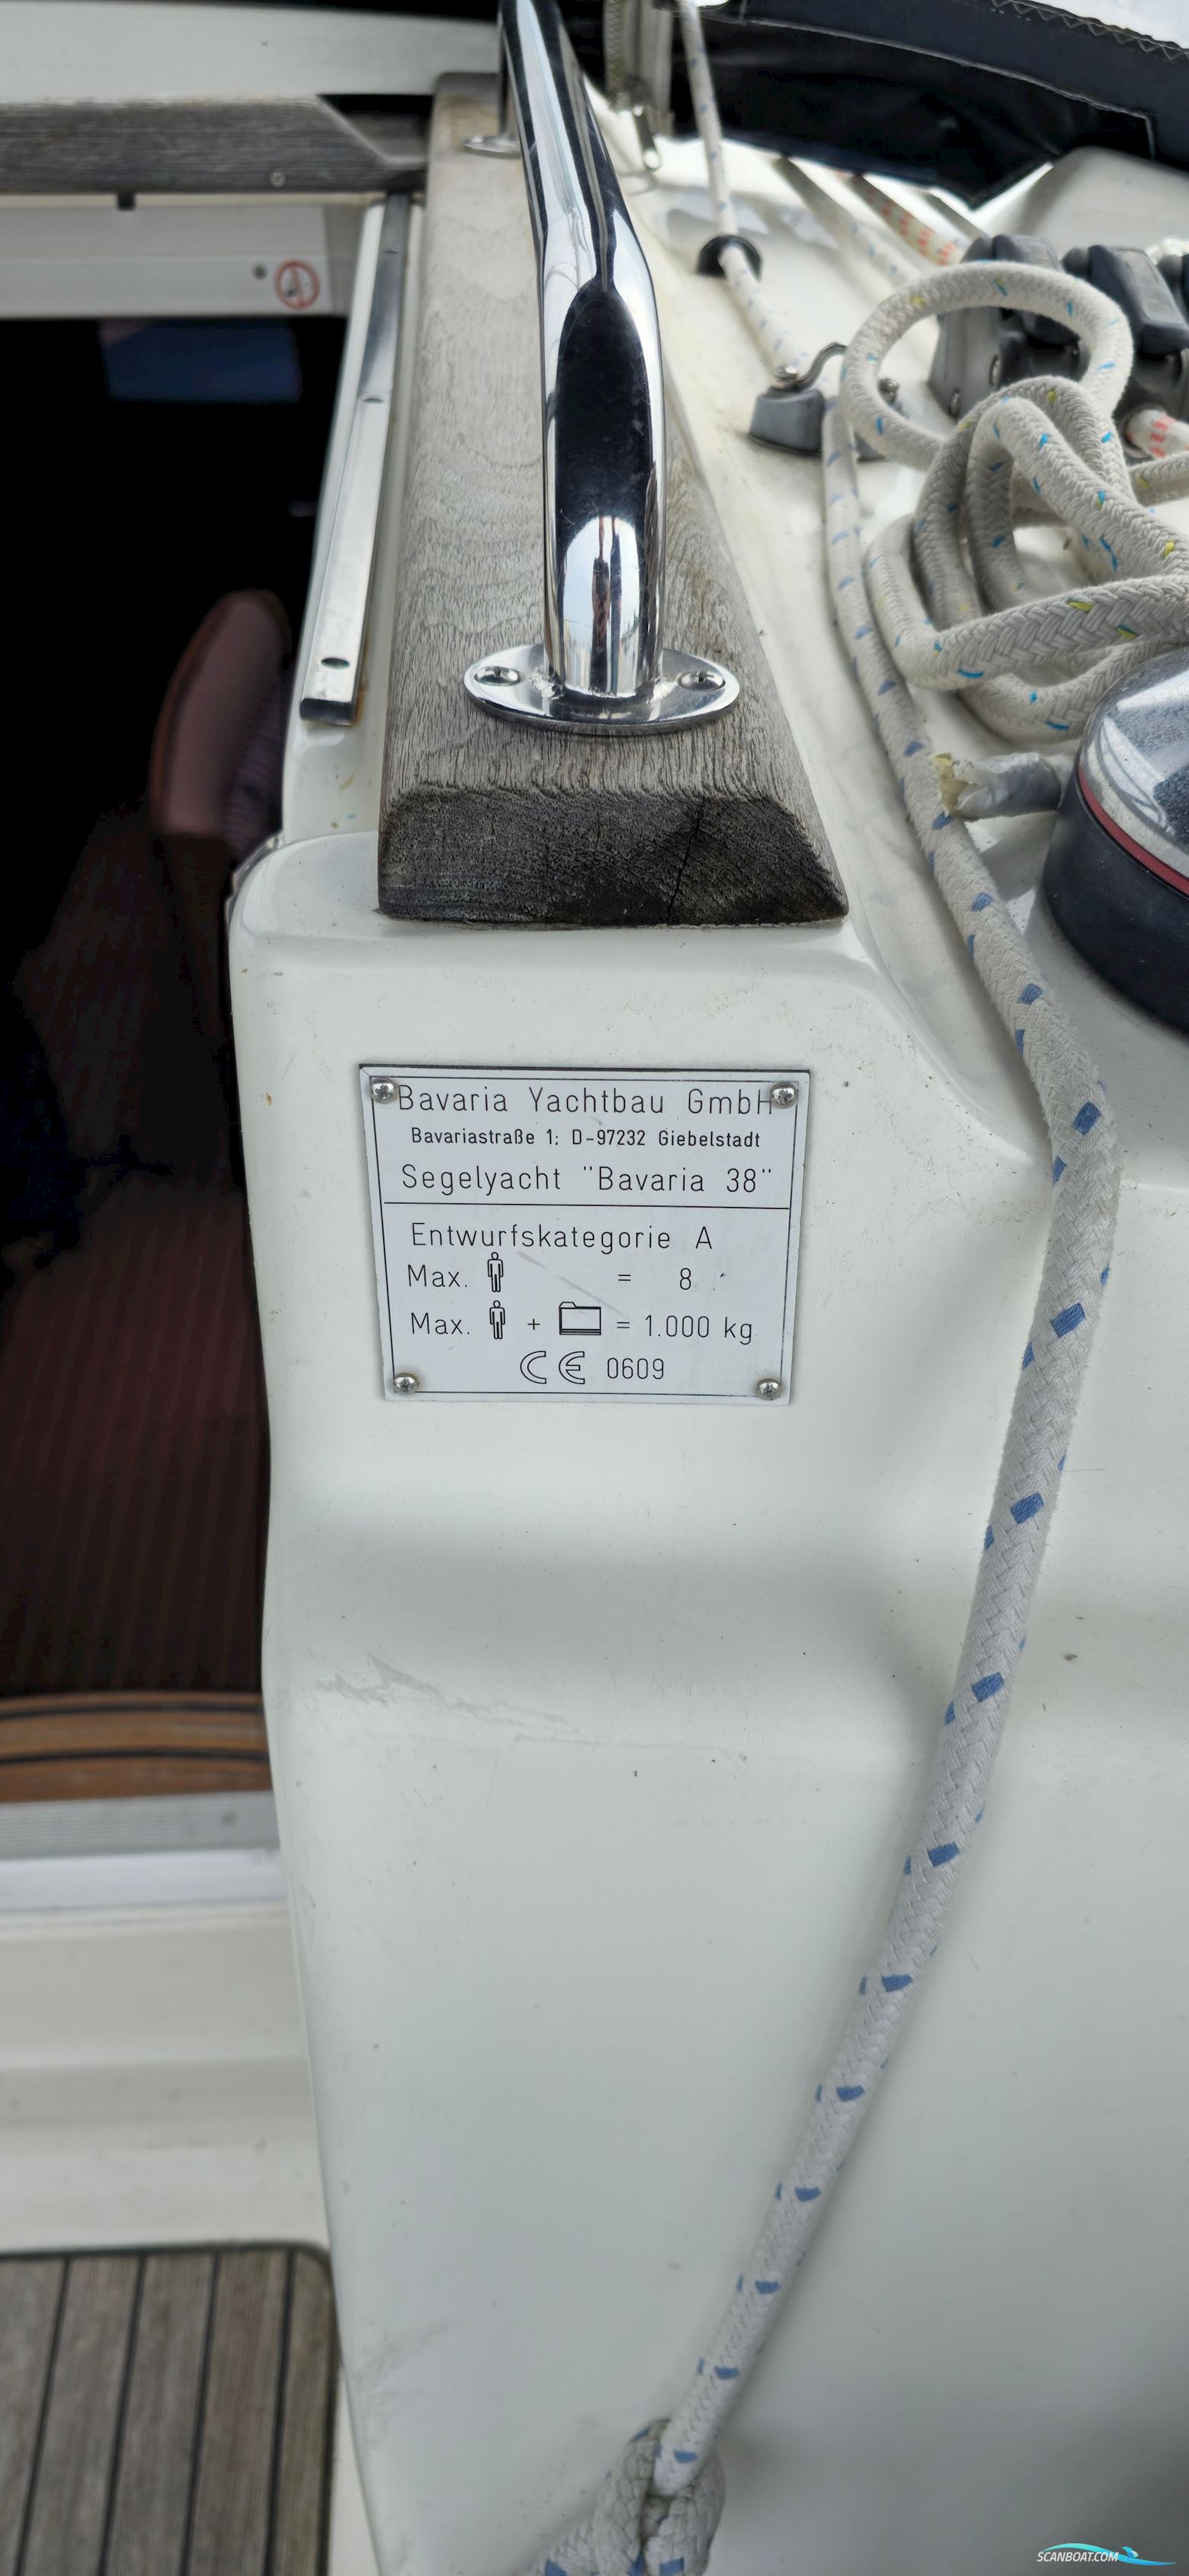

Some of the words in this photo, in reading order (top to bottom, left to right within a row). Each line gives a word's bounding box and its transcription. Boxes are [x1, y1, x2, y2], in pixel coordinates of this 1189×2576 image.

[399, 1084, 508, 1112] Bavaria
[528, 1086, 663, 1113] Yachtbau
[687, 1088, 773, 1115] GmbH
[412, 1126, 535, 1145] Bavariastraße
[572, 1129, 646, 1146] D-97232
[658, 1129, 761, 1148] Giebelstadt
[402, 1163, 561, 1196] Segelyacht
[583, 1165, 705, 1192] "Bavaria
[726, 1168, 772, 1193] 38"
[412, 1222, 671, 1255] Entwurfskategorie
[694, 1226, 713, 1250] A
[407, 1264, 468, 1288] Max.
[679, 1267, 692, 1290] 8
[410, 1312, 470, 1335] Max.
[645, 1314, 710, 1338] 1.000
[723, 1315, 753, 1346] kg
[607, 1357, 665, 1380] 0609
